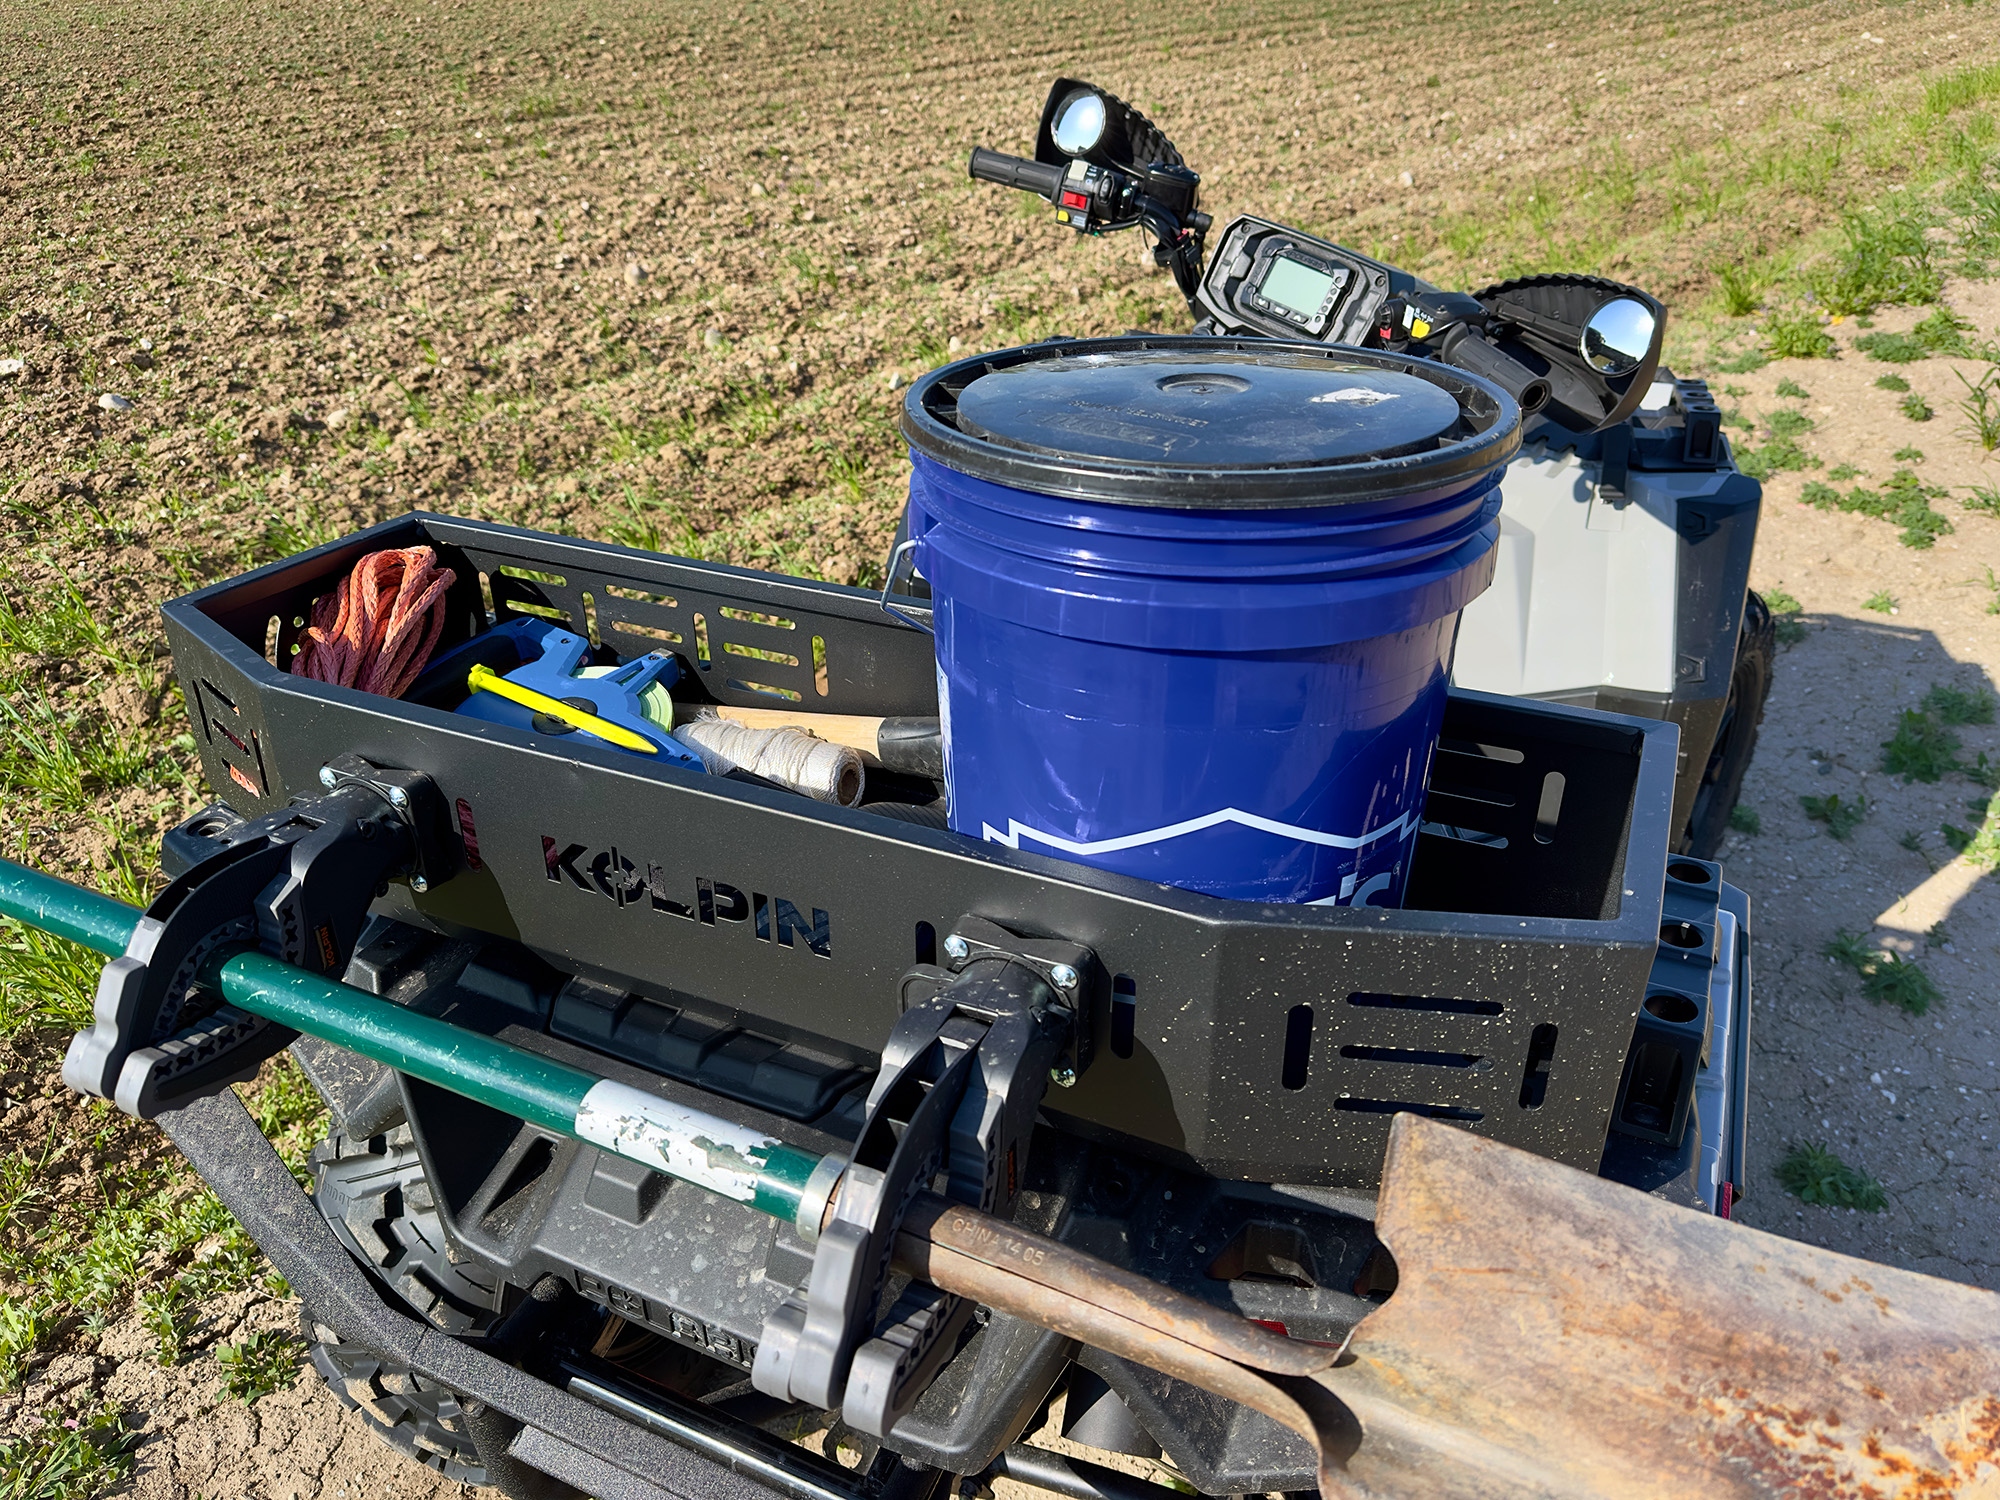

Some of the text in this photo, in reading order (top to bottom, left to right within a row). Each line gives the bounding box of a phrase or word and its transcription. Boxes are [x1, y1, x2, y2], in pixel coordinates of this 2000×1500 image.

[541, 835, 831, 960] KOLPIN
[320, 926, 335, 967] KOLPIN
[952, 1218, 1000, 1244] CHINA
[1023, 1247, 1045, 1265] 05
